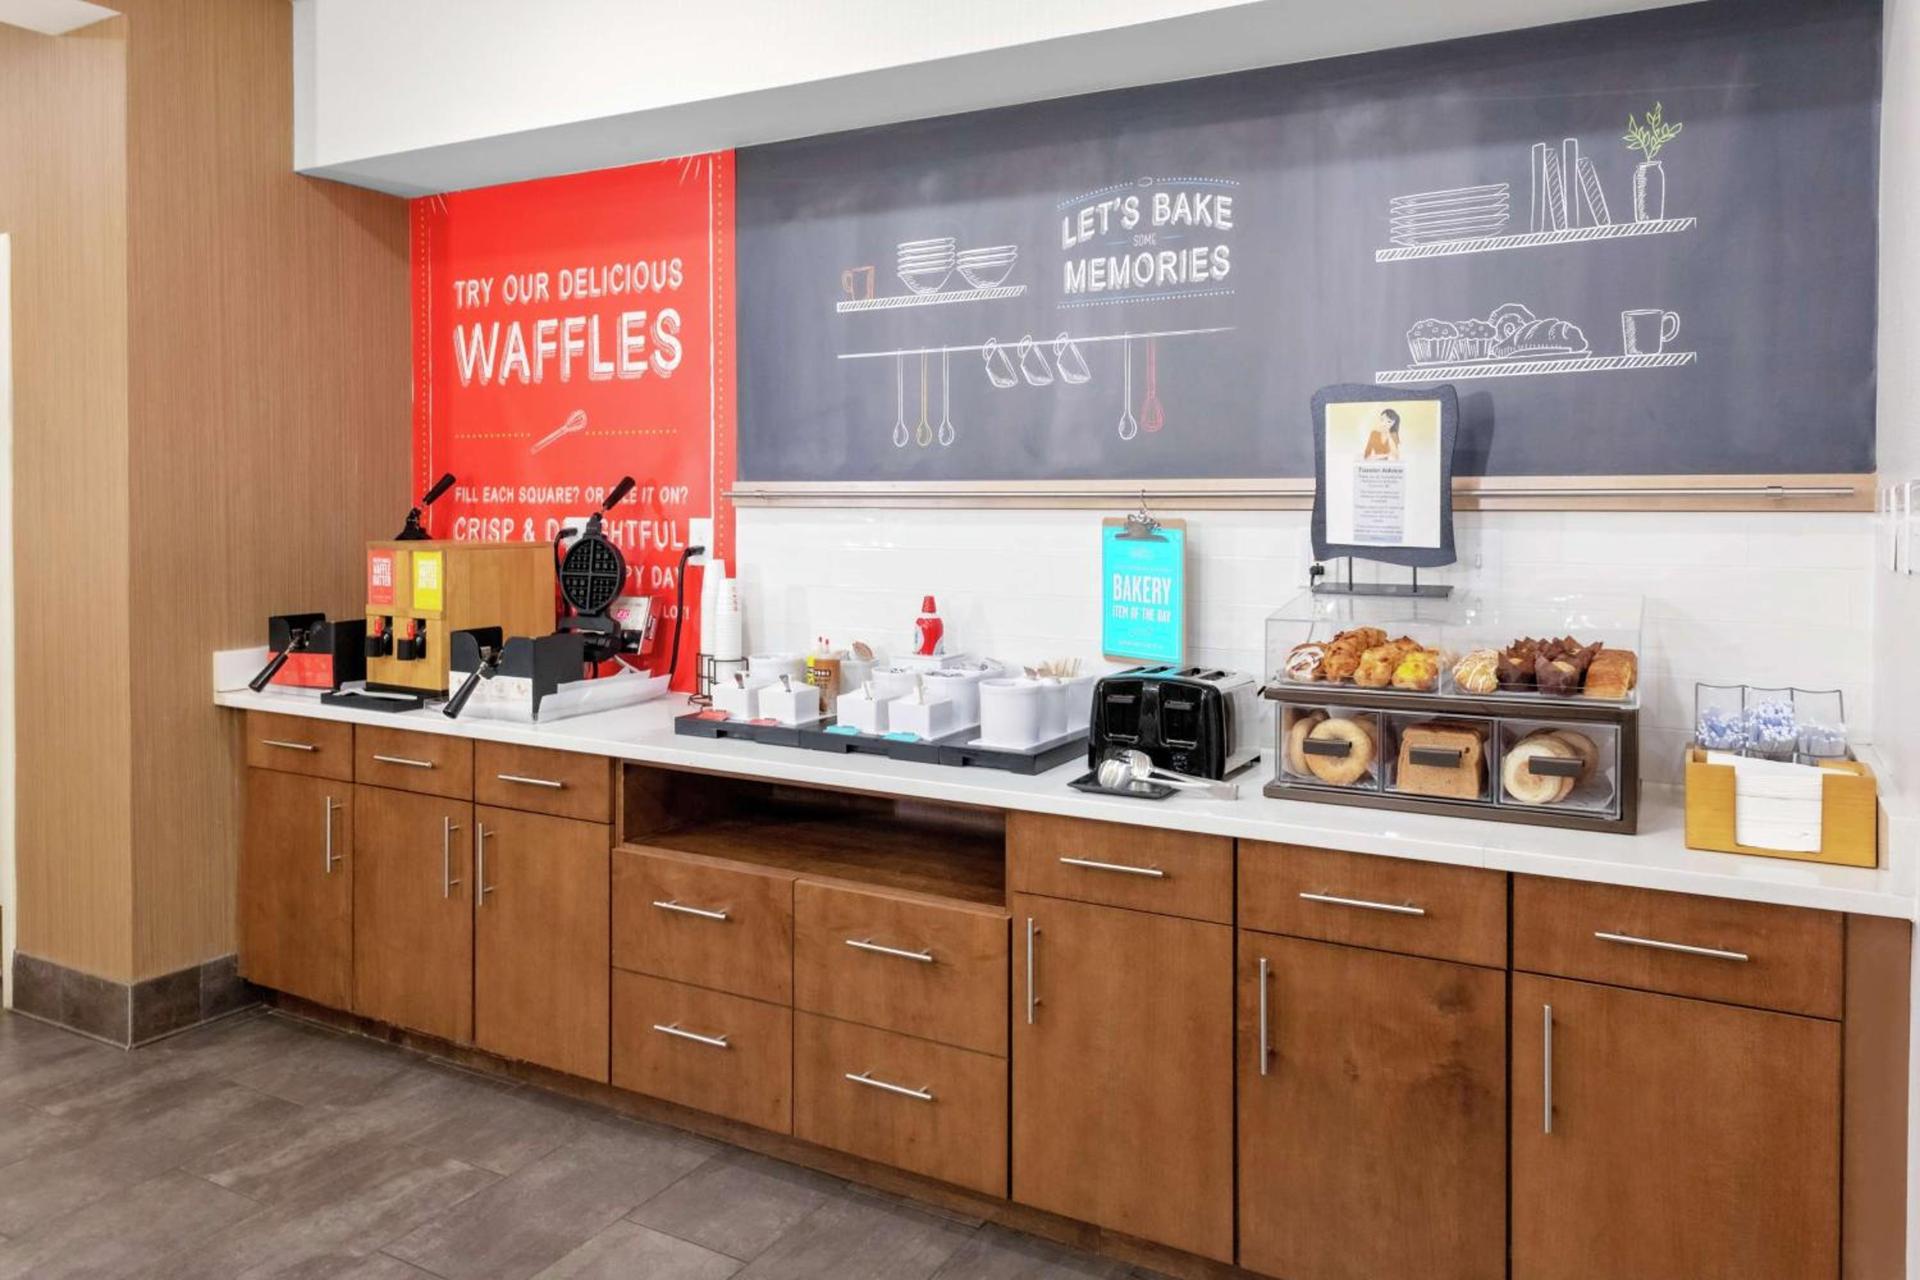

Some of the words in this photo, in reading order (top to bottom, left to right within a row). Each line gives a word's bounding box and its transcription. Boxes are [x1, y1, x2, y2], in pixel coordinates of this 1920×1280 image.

[1061, 195, 1140, 250] LET'S
[1152, 192, 1234, 231] BAKE
[1133, 232, 1157, 247] SOME
[453, 277, 493, 309] TRY
[502, 271, 549, 304] OUR
[558, 257, 684, 301] DELICIOUS
[1063, 244, 1231, 294] MEMORIES
[453, 307, 683, 388] WAFFLES
[455, 486, 479, 502] FILL
[482, 486, 514, 504] EACH
[518, 486, 580, 504] SQUARE?
[585, 486, 604, 505] OR
[641, 486, 655, 505] IT
[659, 486, 690, 505] ON?
[453, 516, 515, 543] CRISP
[523, 517, 536, 543] &
[651, 565, 680, 591] DA
[1113, 572, 1171, 605] BAKERY
[1113, 605, 1128, 620] ITEM
[1131, 606, 1139, 620] OF
[1143, 607, 1154, 621] THE
[1158, 608, 1171, 624] DAY
